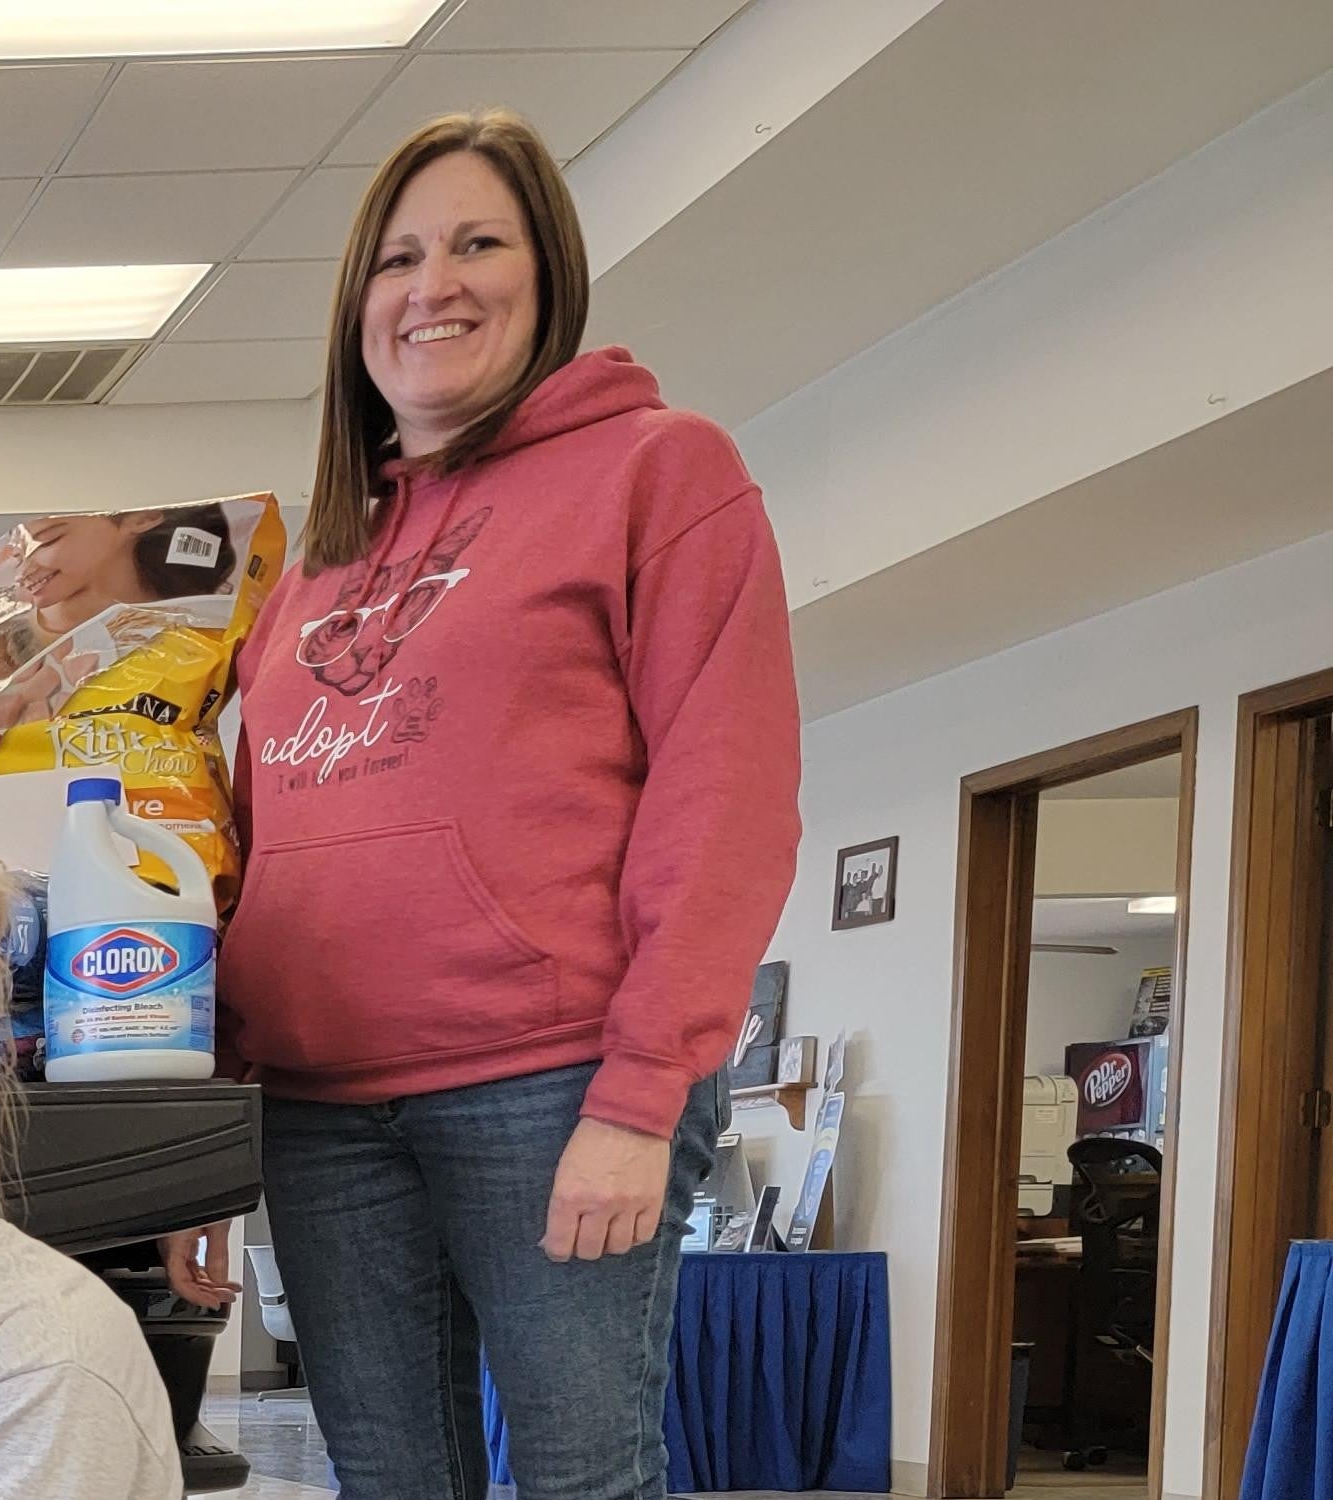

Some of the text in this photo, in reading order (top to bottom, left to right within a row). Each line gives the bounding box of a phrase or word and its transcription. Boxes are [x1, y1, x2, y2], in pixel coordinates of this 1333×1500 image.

[261, 676, 403, 785] adopt
[120, 746, 196, 776] Chow
[83, 946, 166, 977] CLOROX
[82, 1002, 164, 1015] Disinfecting Bleach
[1088, 1062, 1129, 1105] Pepper
[1099, 1060, 1118, 1082] Dr
